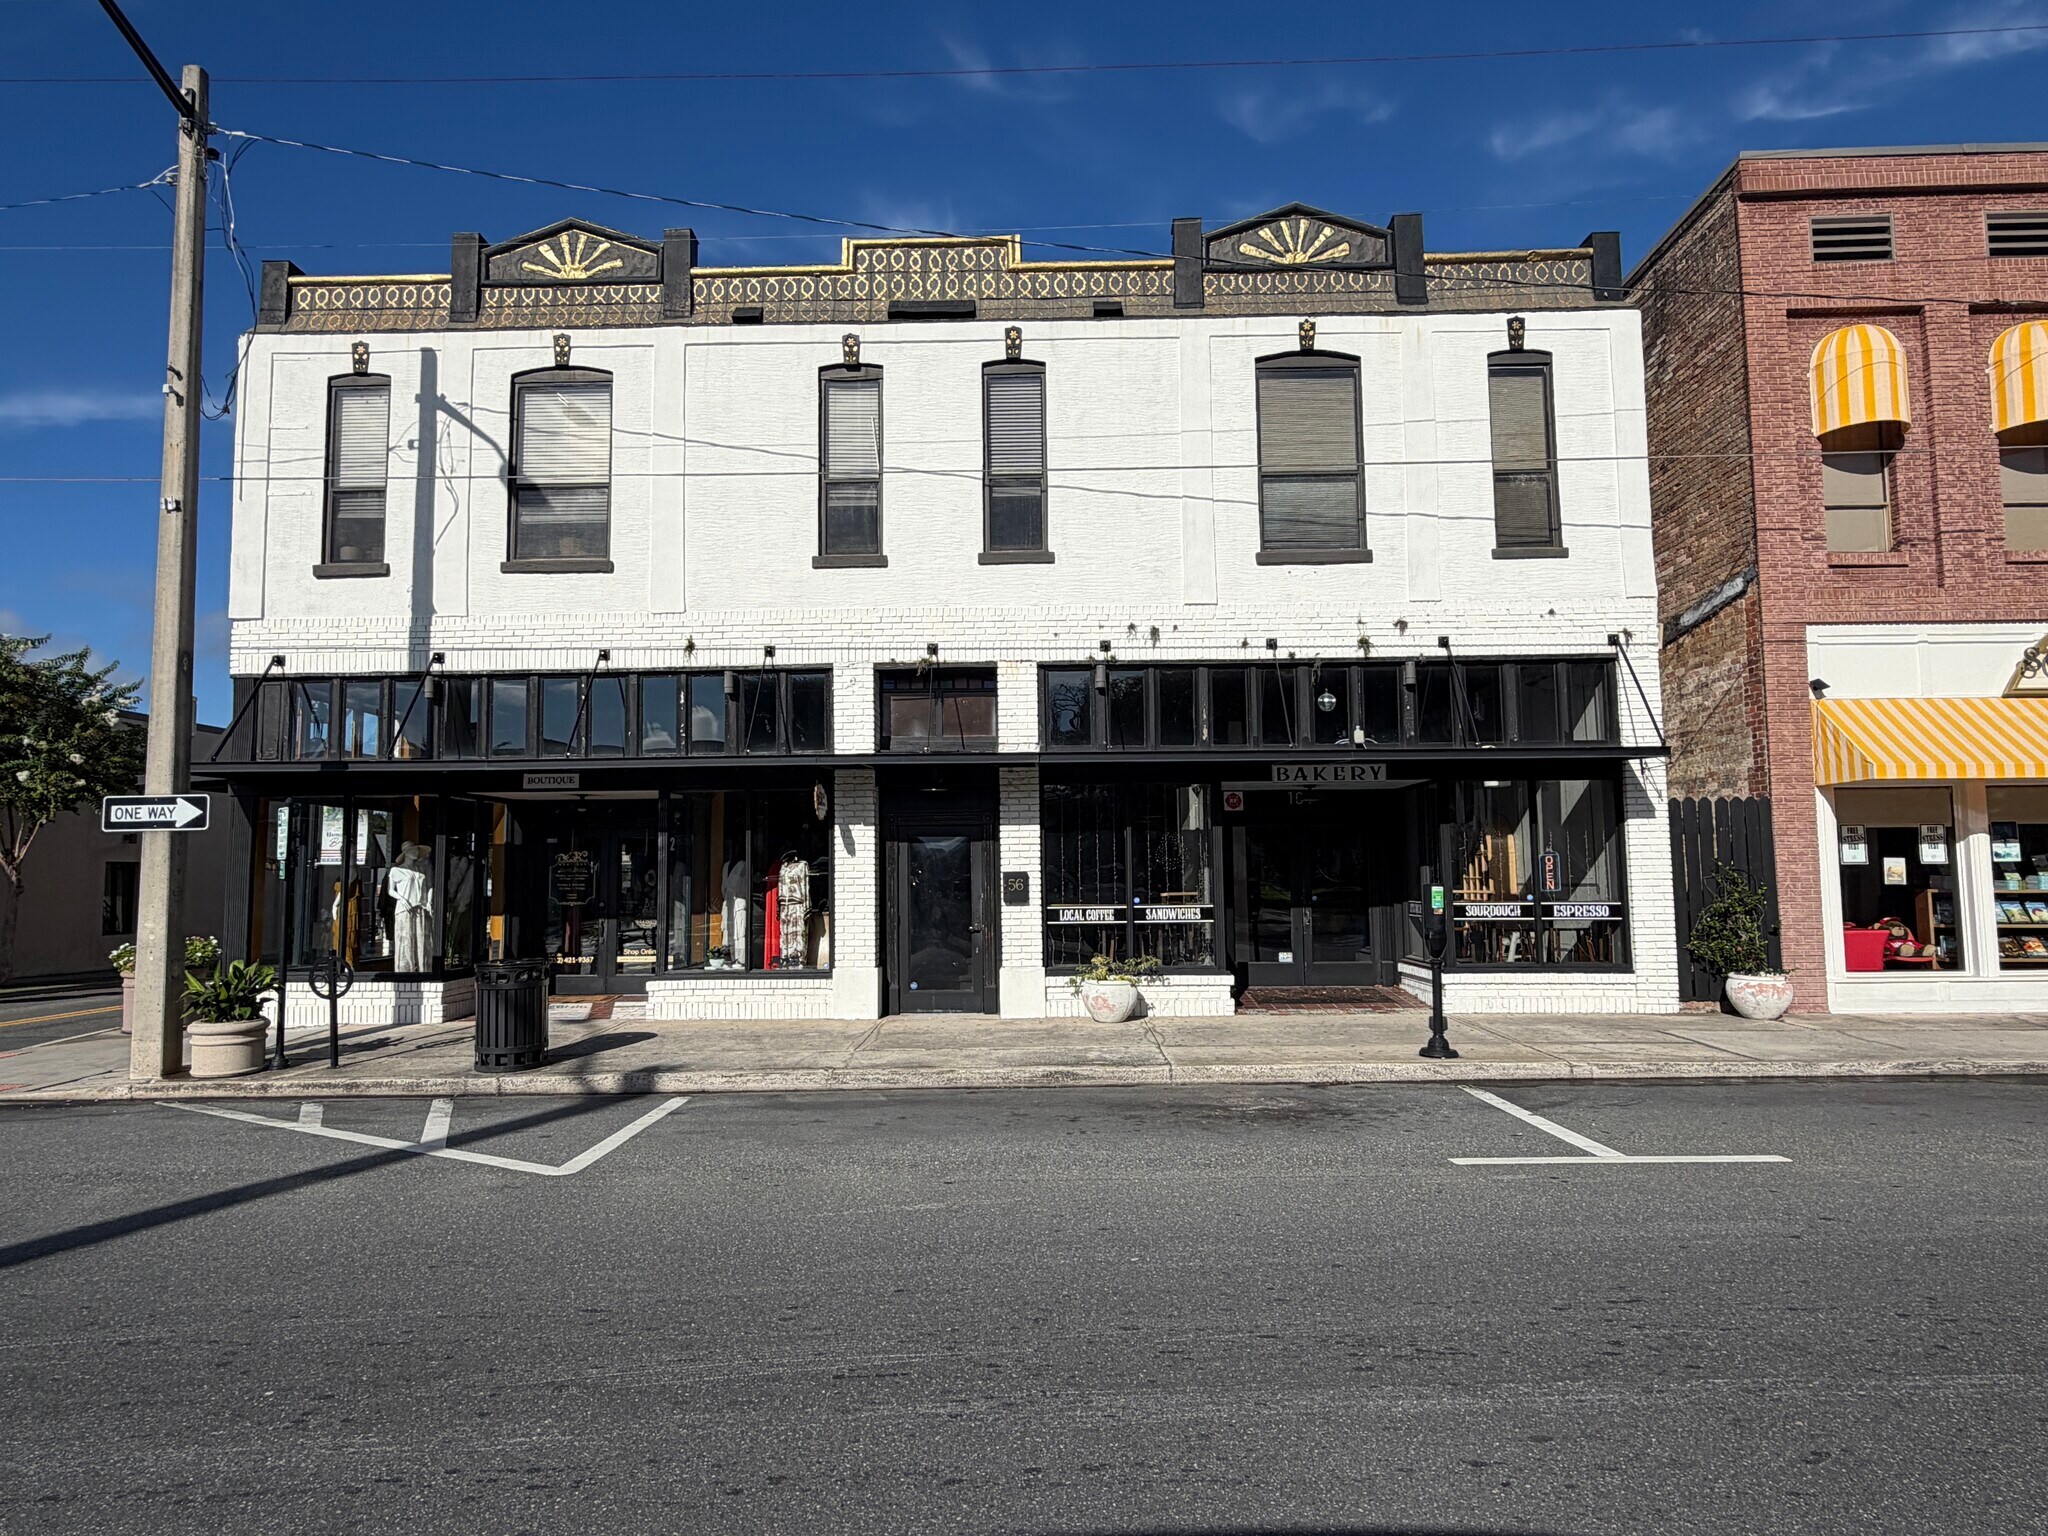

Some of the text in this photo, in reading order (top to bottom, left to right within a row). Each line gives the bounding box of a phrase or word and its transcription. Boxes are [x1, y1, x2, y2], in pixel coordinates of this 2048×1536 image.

[1276, 766, 1382, 782] BAKERY
[527, 776, 575, 785] BOUTIQUE
[114, 806, 177, 820] ONE WAY
[1846, 826, 1858, 834] FREE
[1926, 825, 1938, 833] FREE
[1545, 856, 1555, 890] OPEN
[1008, 878, 1024, 891] 56
[1059, 909, 1115, 921] LOCAL COFFEE
[1145, 908, 1201, 920] SANDWICHES
[1465, 905, 1521, 918] SOURDOUGH
[1553, 905, 1610, 917] ESPRESSO
[623, 948, 640, 956] Shop
